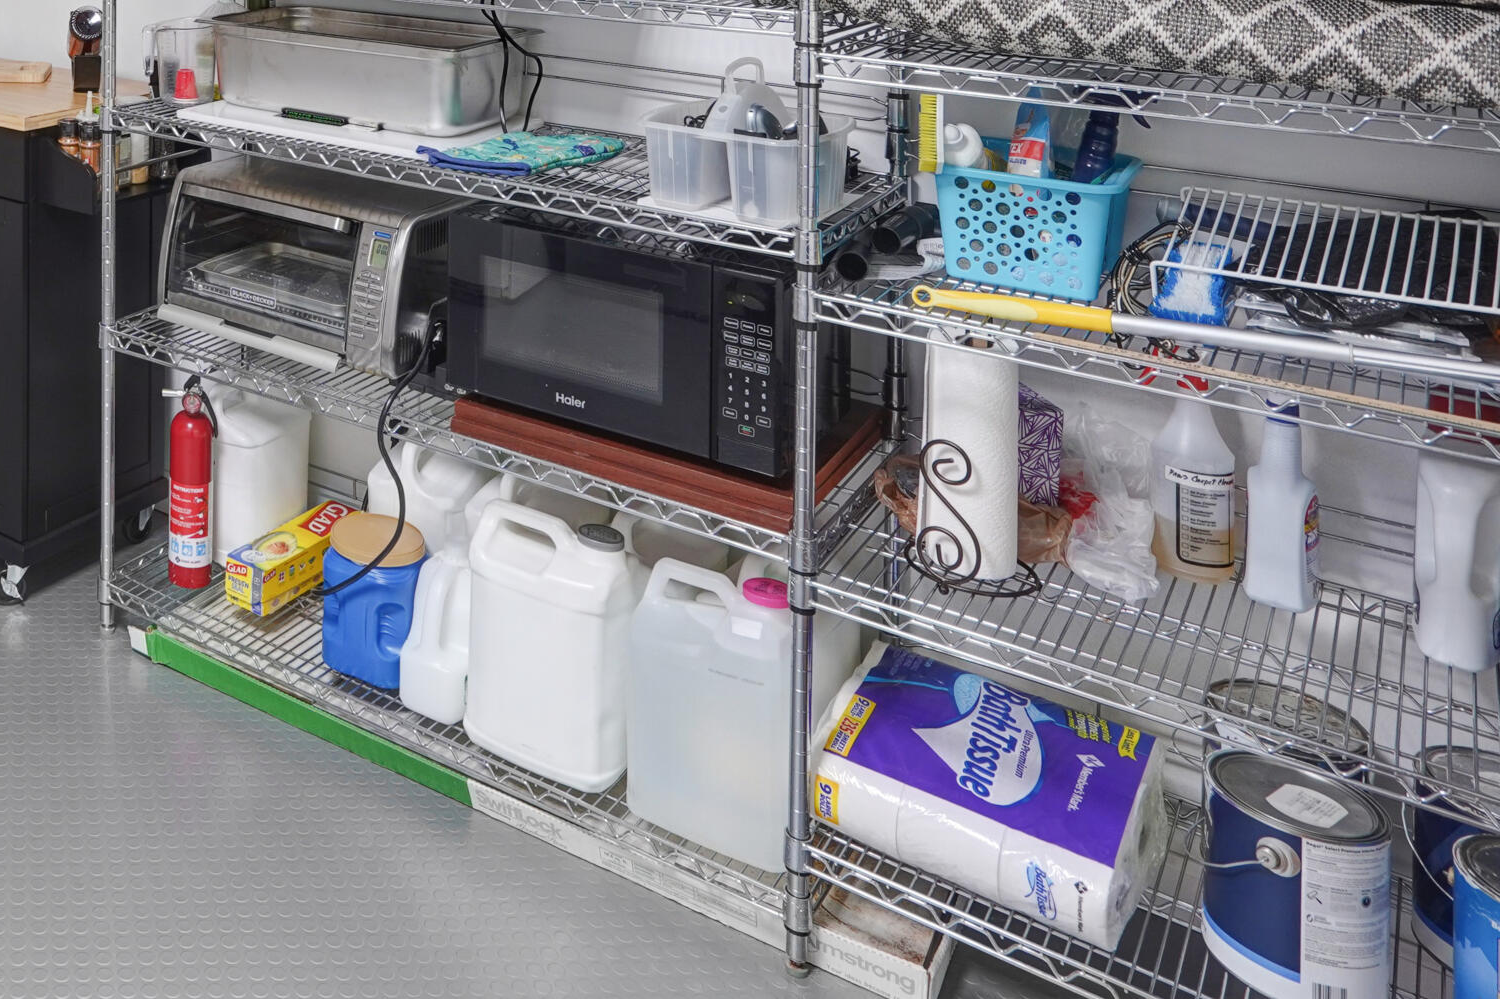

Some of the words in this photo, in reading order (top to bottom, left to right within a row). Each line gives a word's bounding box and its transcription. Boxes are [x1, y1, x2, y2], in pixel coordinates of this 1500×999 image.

[556, 392, 586, 408] Haier
[308, 504, 349, 534] GLAD
[228, 564, 247, 575] GLAD
[859, 697, 869, 708] 9
[839, 716, 859, 736] 235
[837, 734, 850, 752] SHEETS
[1023, 730, 1034, 746] Ultra
[1015, 744, 1030, 779] Premium
[819, 782, 832, 795] 9
[1074, 766, 1093, 794] Member's
[476, 789, 563, 840] SwiftLock
